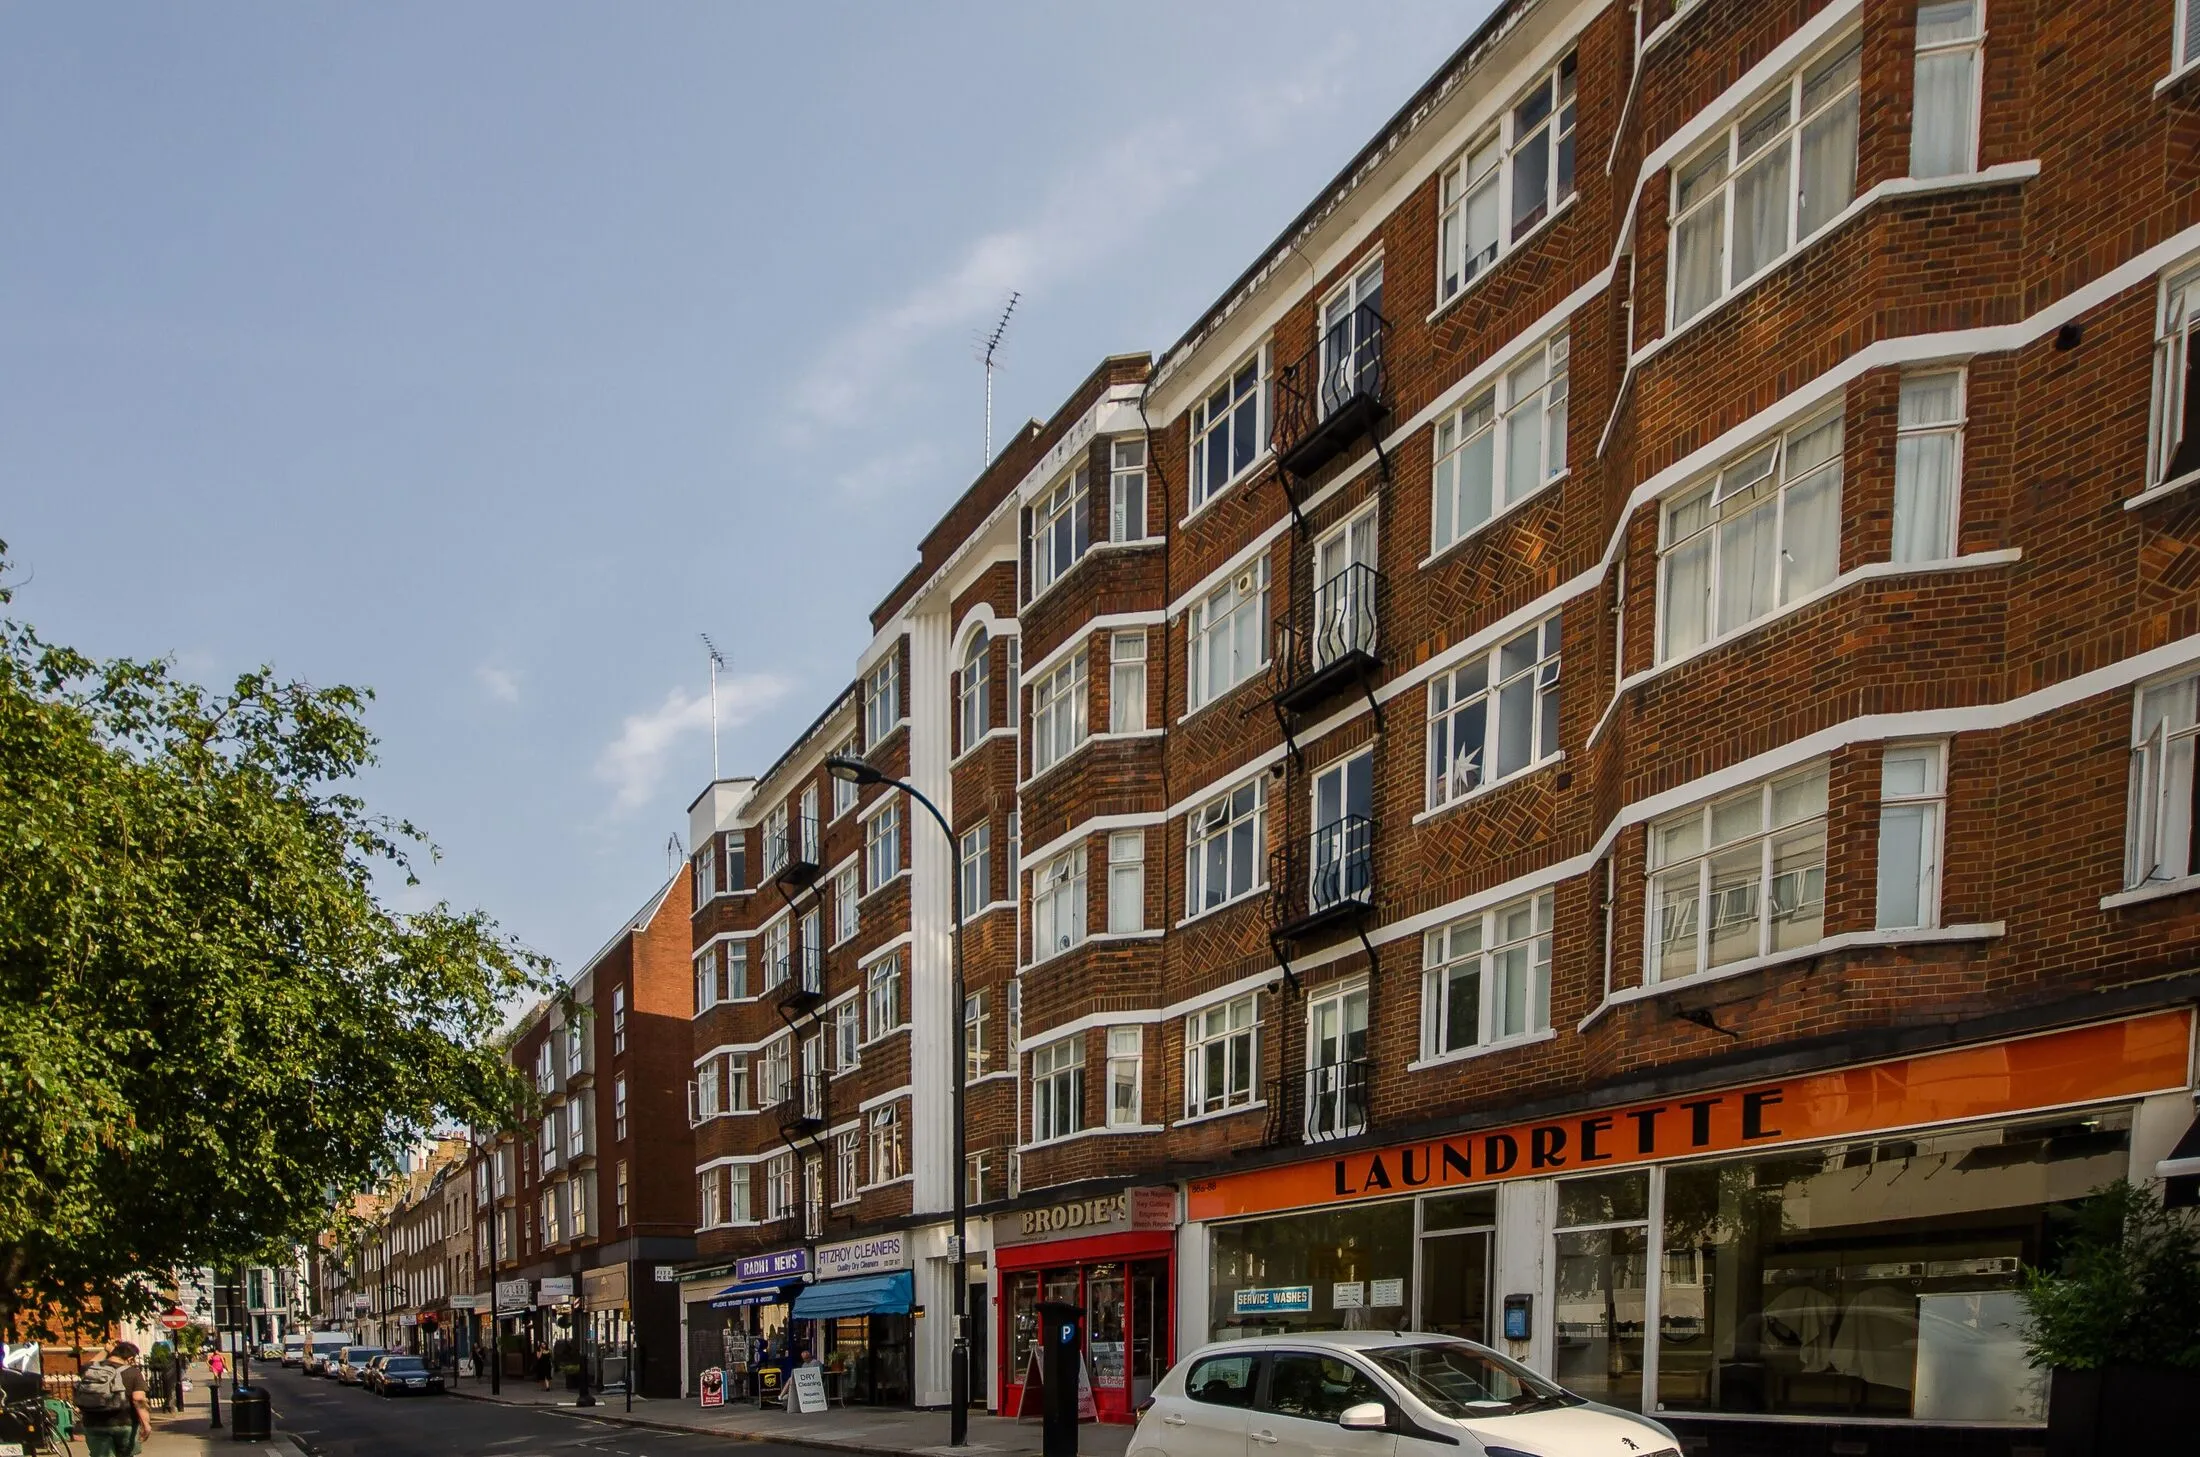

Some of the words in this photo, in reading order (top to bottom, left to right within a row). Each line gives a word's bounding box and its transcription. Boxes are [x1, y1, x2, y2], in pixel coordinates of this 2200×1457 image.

[1334, 1088, 1785, 1196] LAUNDRETTE
[1020, 1195, 1126, 1236] BRODIE'S
[819, 1248, 851, 1266] FITZROY
[854, 1238, 900, 1260] CLEANERS
[743, 1259, 769, 1276] RADHI
[774, 1254, 798, 1271] NEWS
[837, 1263, 851, 1272] Quality
[851, 1262, 859, 1271] Dry
[860, 1259, 879, 1269] Cleaners
[1238, 1293, 1269, 1305] SERVICE
[1273, 1291, 1307, 1304] WASHES
[1062, 1325, 1072, 1341] P
[800, 1373, 816, 1381] DRY
